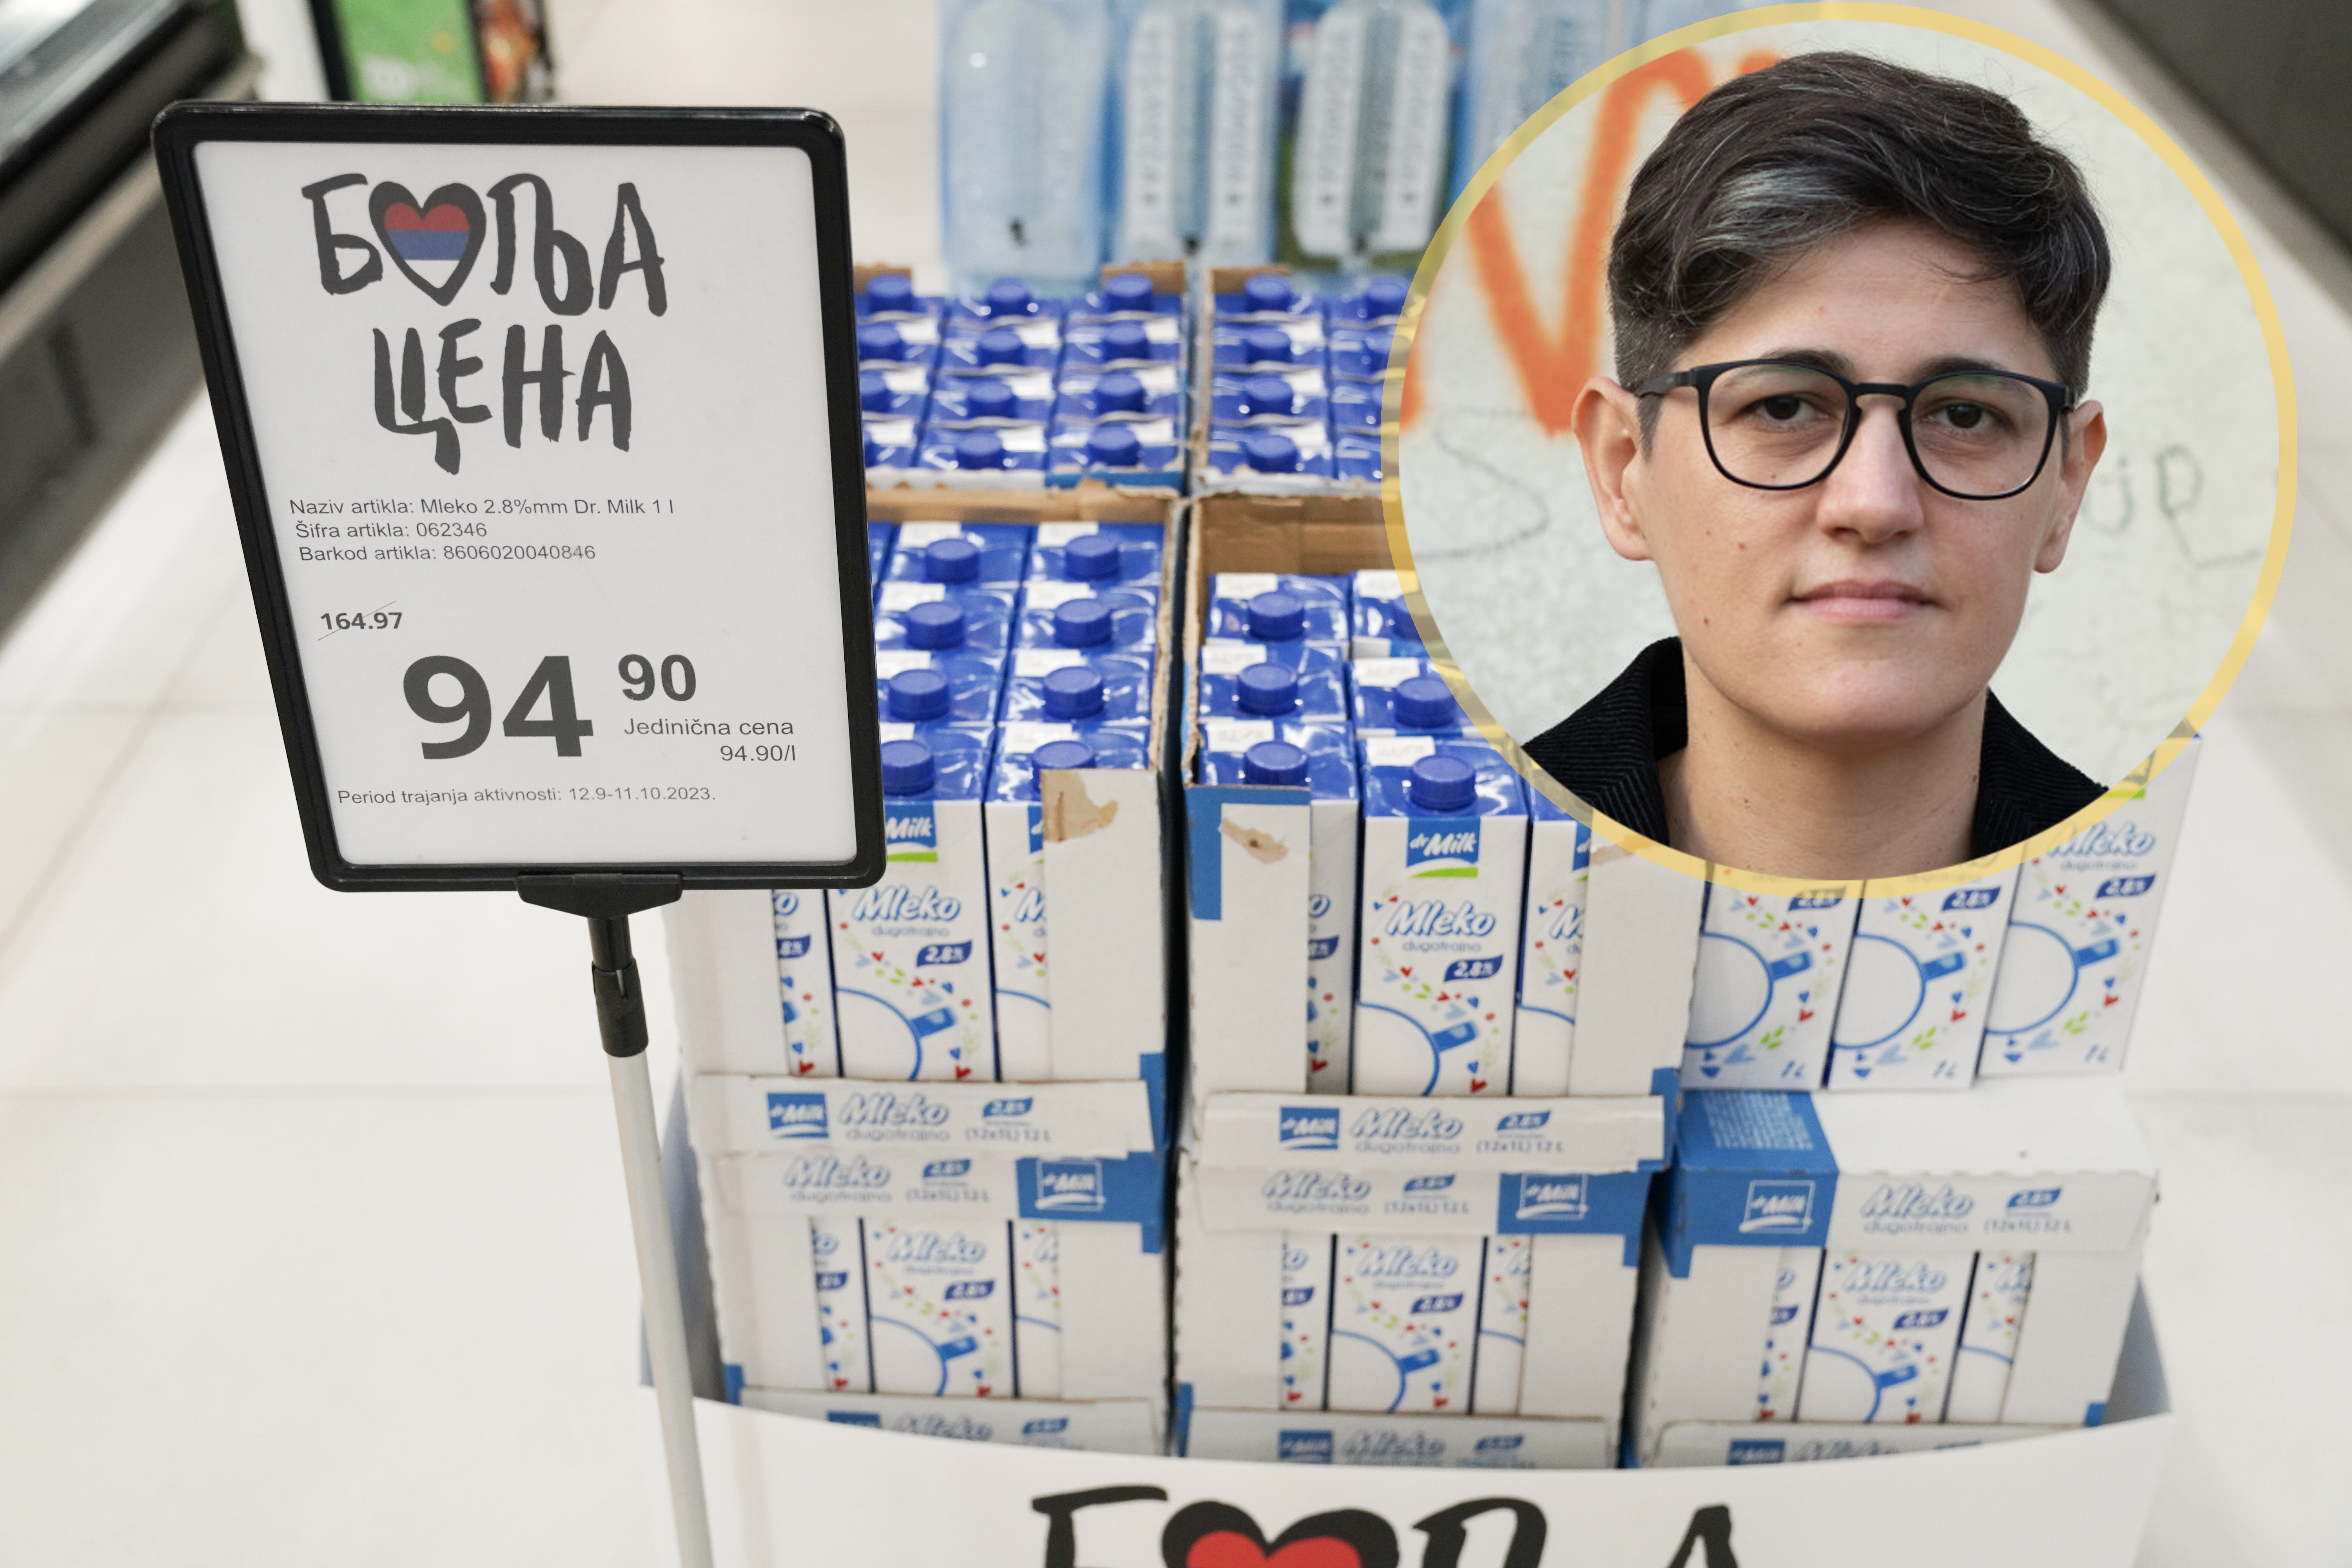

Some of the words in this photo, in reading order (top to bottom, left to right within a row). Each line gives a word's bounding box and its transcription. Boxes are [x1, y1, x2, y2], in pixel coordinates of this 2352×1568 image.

[372, 318, 632, 475] ЦЕНА
[290, 499, 344, 514] Naziv
[351, 499, 414, 514] artikla:
[421, 499, 477, 514] Mleko
[484, 499, 568, 514] 2.8%mm
[574, 499, 601, 514] Dr.
[607, 499, 646, 514] Milk
[653, 499, 660, 514] 1
[296, 520, 340, 538] Šifra
[347, 523, 409, 537] artikla:
[416, 523, 487, 537] 062346
[299, 546, 368, 561] Barkod
[375, 546, 437, 560] artikla:
[443, 545, 596, 559] 8606020040846
[320, 612, 403, 630] 164.97
[403, 655, 593, 760] 94
[618, 654, 697, 702] 90
[624, 718, 731, 735] Jedinična
[739, 722, 794, 735] cena
[338, 790, 396, 804] Period
[401, 789, 468, 806] trajanja
[474, 788, 562, 801] aktivnosti:
[569, 787, 715, 800] 12.9-11.10.2023.
[886, 817, 933, 839] Milk
[1423, 832, 1478, 856] Milk
[852, 884, 962, 922] Mleko
[1384, 900, 1496, 936] Mleko
[837, 1091, 950, 1126] Mleko
[1349, 1107, 1464, 1139] Mleko
[1860, 1183, 1975, 1218] Mleko
